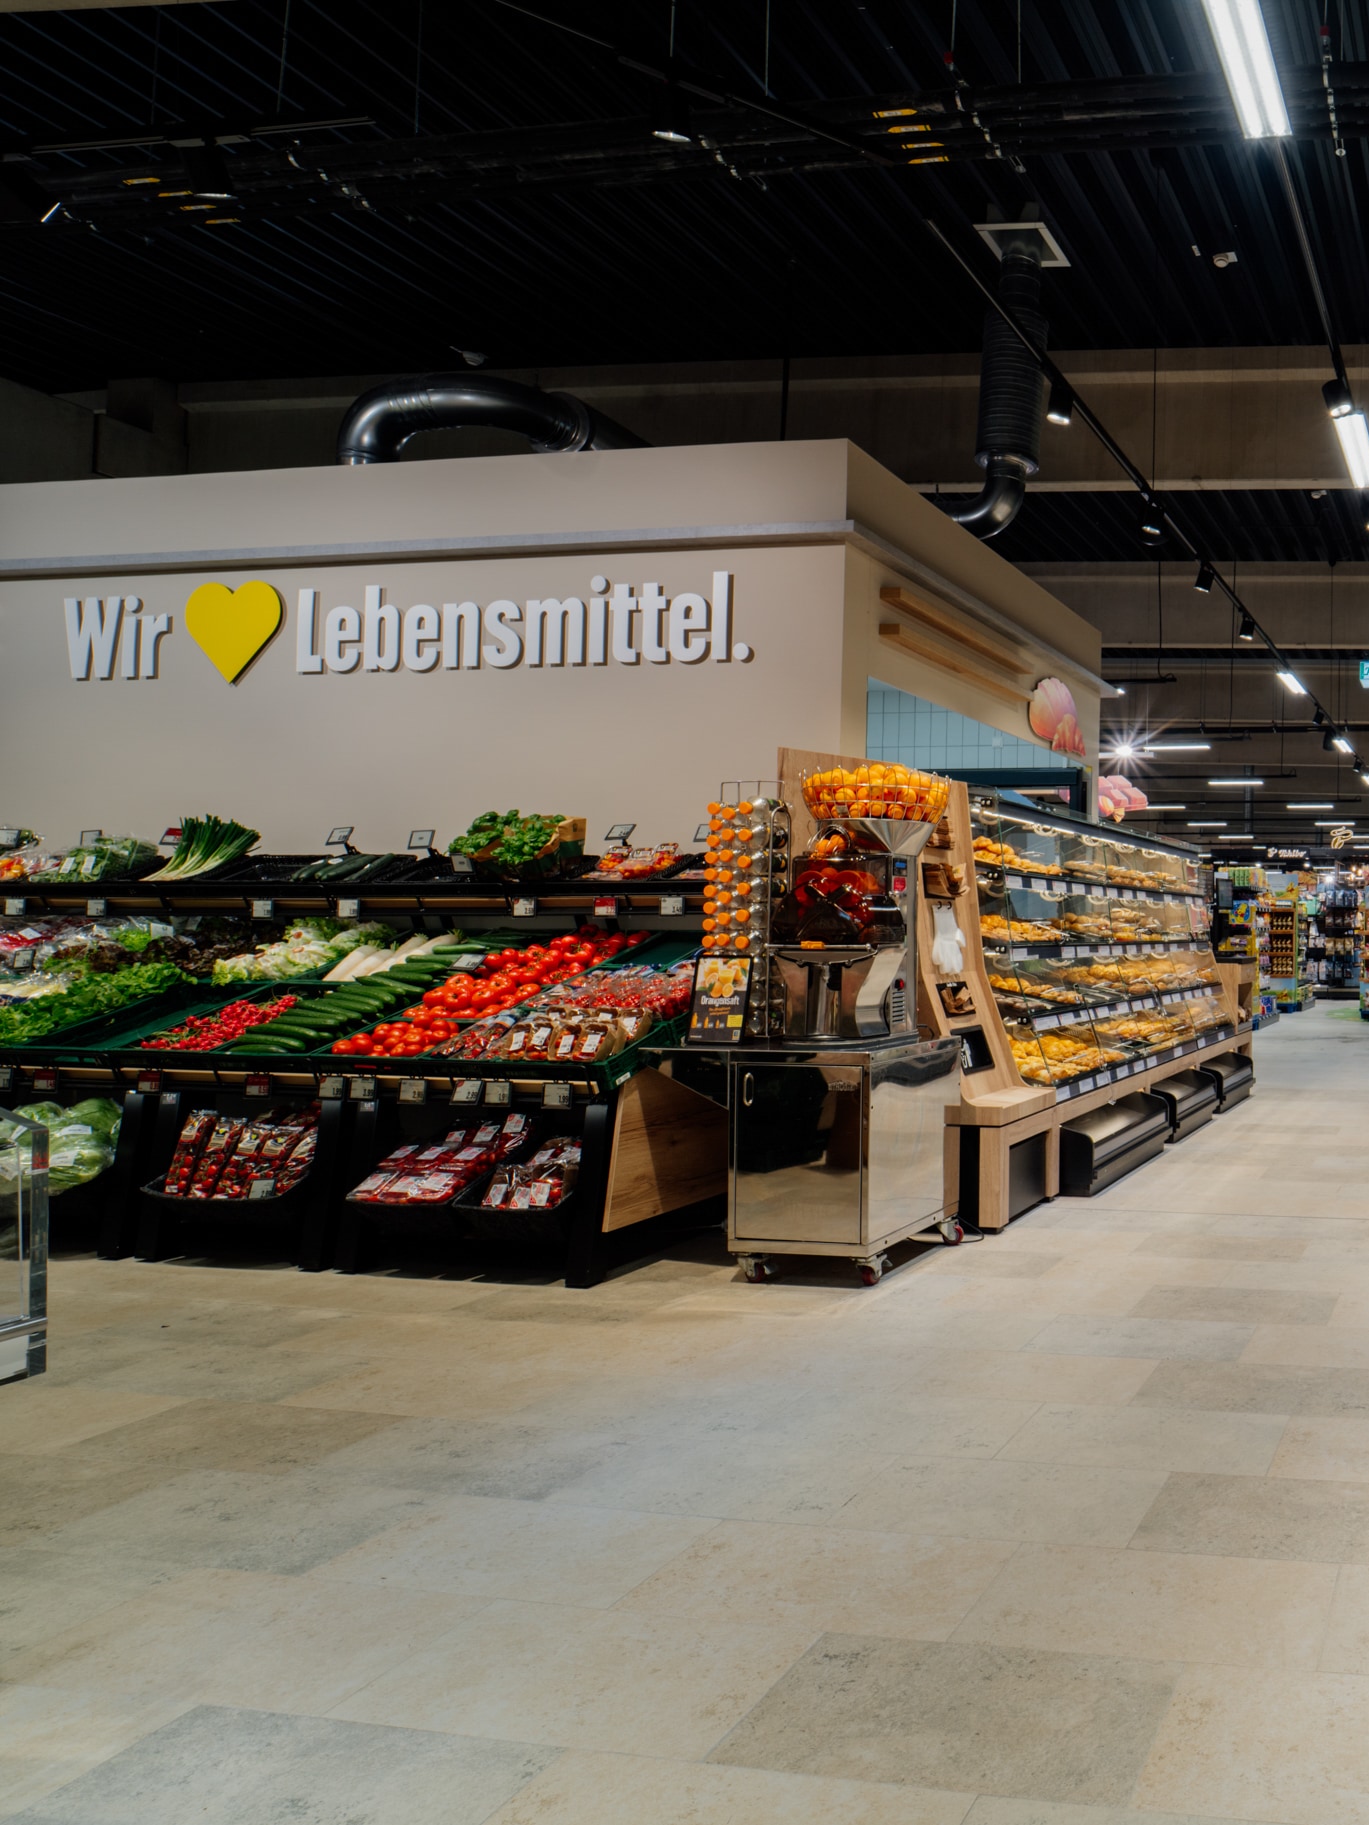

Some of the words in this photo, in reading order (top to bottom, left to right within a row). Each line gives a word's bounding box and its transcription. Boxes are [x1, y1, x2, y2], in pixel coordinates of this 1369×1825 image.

[64, 595, 171, 680] Wir
[296, 570, 750, 674] Lebensmittel.
[701, 995, 740, 1007] Orangensaft
